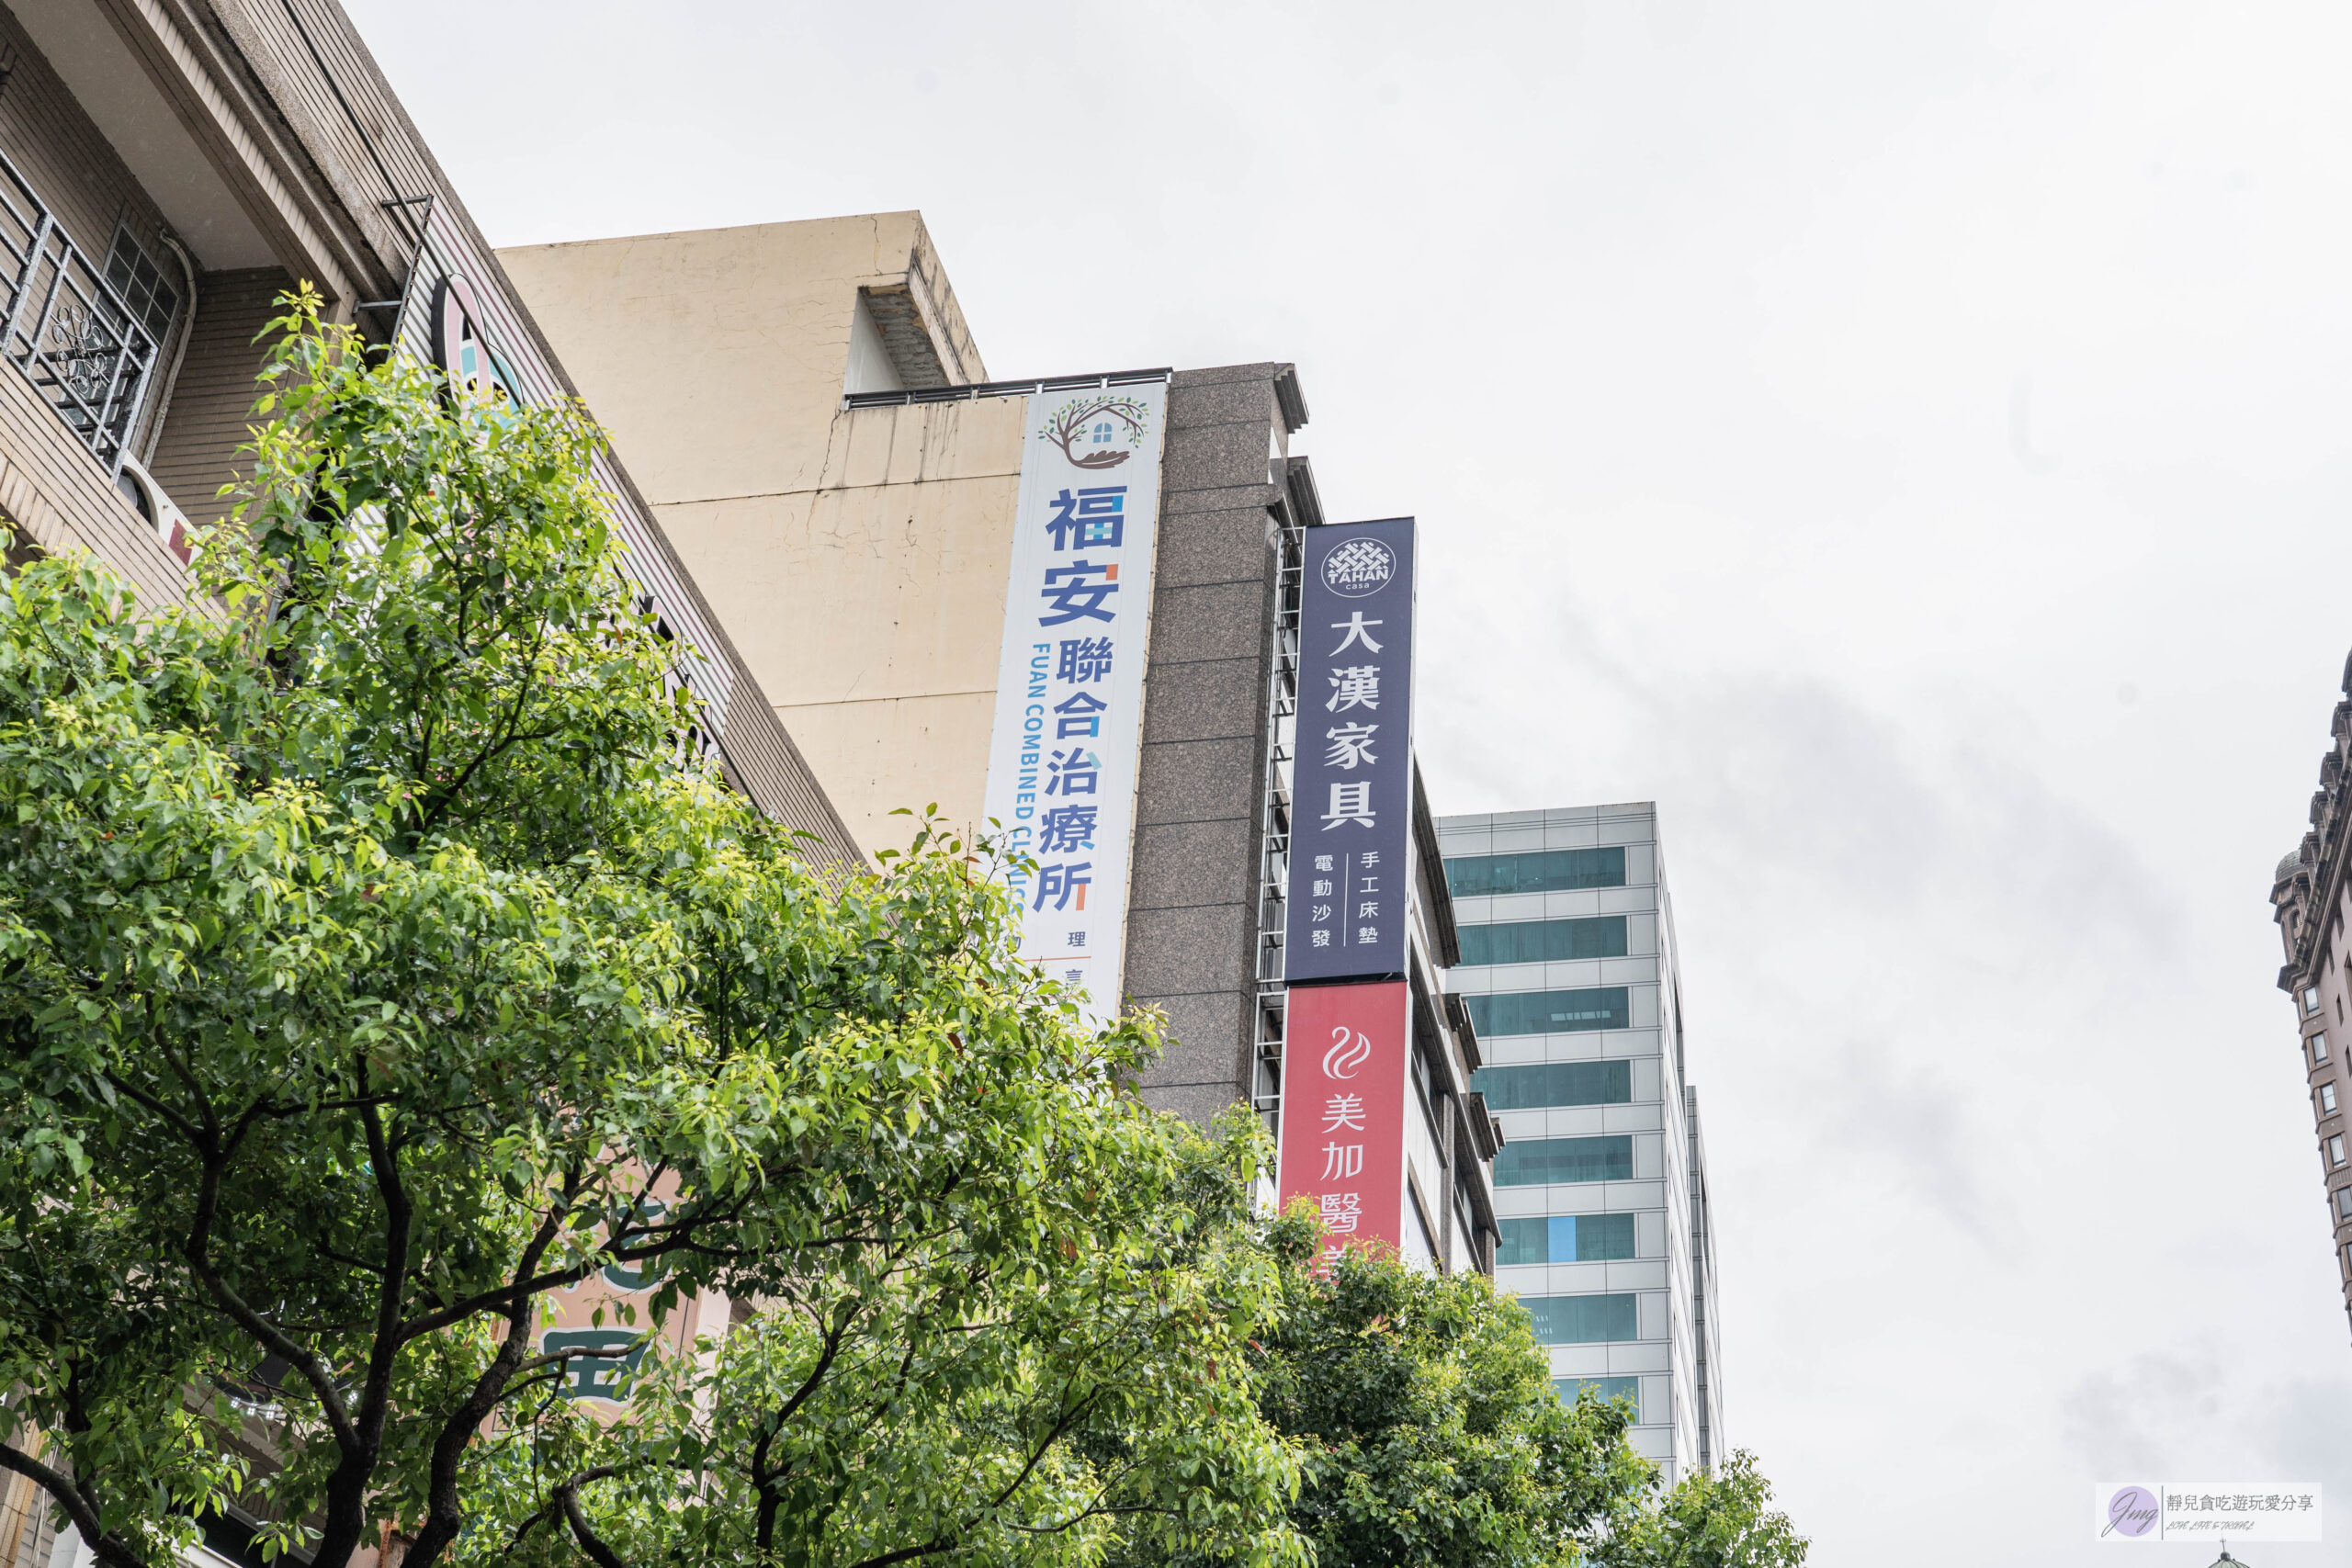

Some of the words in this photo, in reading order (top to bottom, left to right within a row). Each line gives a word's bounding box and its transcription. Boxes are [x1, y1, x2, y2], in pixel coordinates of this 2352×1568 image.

[1328, 567, 1389, 584] TAHAN
[1027, 643, 1051, 698] FUAN
[1032, 485, 1127, 913] 福安聯合治療所
[1015, 704, 1045, 819] COMBINED
[1320, 611, 1384, 831] 大漢家具
[1311, 854, 1333, 947] 電動沙發
[1358, 851, 1380, 944] 手工床墊
